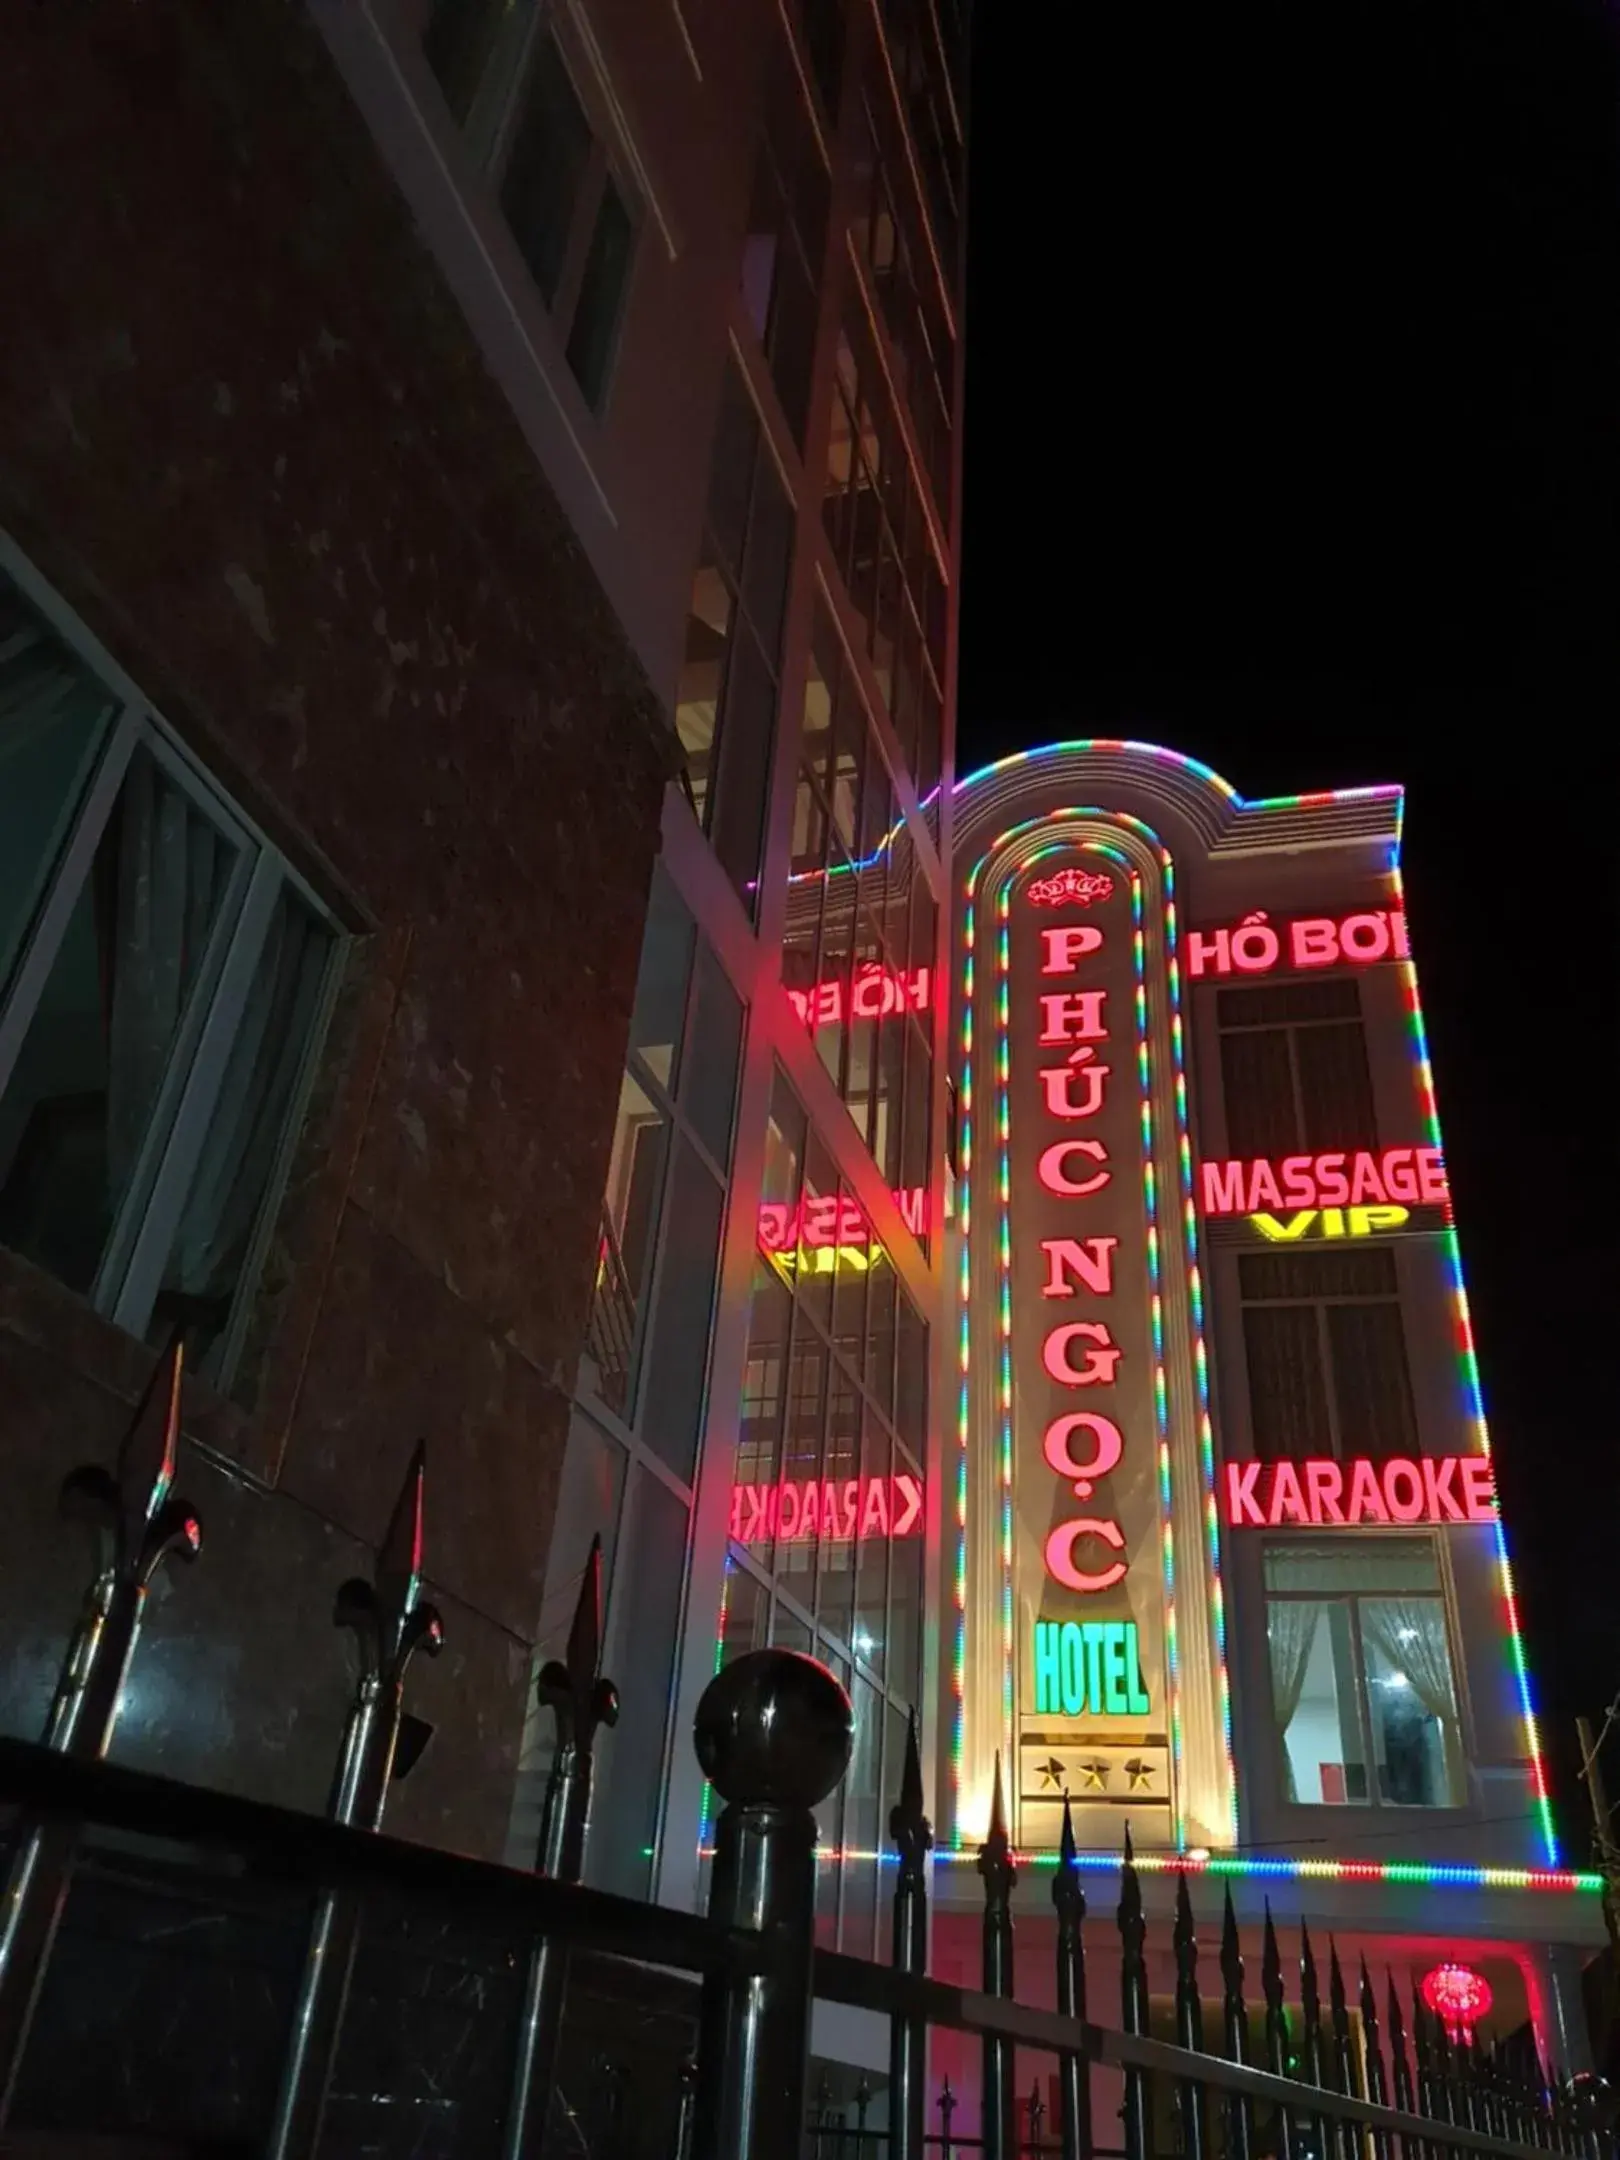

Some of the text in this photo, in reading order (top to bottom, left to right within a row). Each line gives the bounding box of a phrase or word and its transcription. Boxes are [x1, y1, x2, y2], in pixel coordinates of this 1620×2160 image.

[1188, 910, 1409, 976] HỒ BƠI
[1202, 1147, 1450, 1213] MASSAGE
[1247, 1204, 1410, 1242] VIP
[1039, 926, 1128, 1591] PHÚC NGỌC
[1227, 1457, 1499, 1525] KARAOKE
[1035, 1620, 1150, 1715] HOTEL
